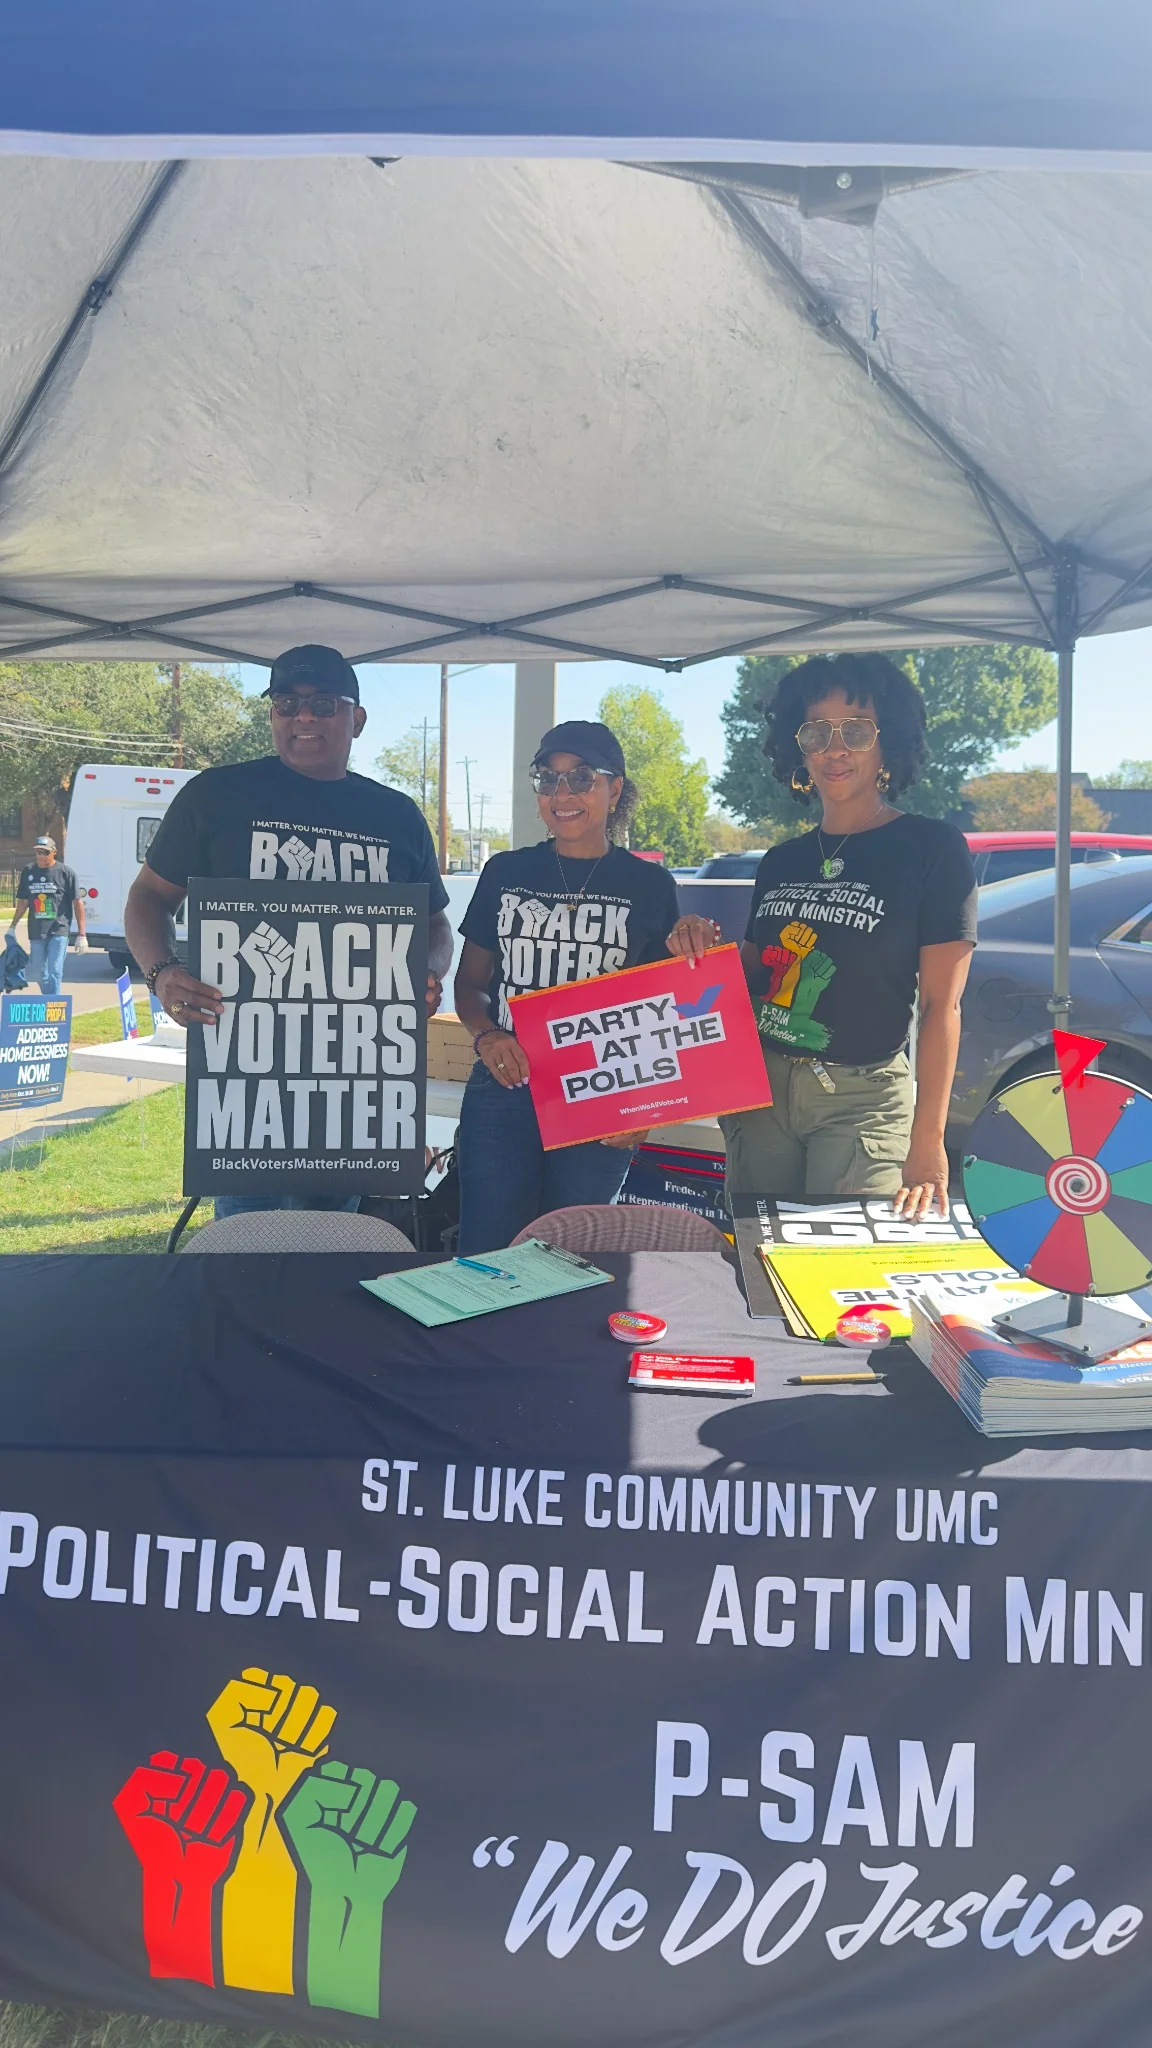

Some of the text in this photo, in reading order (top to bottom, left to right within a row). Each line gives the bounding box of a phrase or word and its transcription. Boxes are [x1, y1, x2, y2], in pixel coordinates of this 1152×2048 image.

[256, 821, 291, 830] MATTER.
[292, 824, 310, 832] YOU
[311, 827, 345, 838] MATTER.
[809, 881, 852, 889] COMMUNITY
[851, 881, 870, 892] UMC
[199, 901, 417, 916] I MATTER. YOU MATTER. WE MATTER.
[553, 892, 586, 900] MATTER.
[601, 895, 633, 906] MATTER.
[799, 902, 880, 933] MINISTRY
[10, 1003, 31, 1022] VOTE
[31, 1003, 46, 1022] FOR
[61, 1008, 66, 1021] A
[552, 998, 670, 1045] PARTY
[761, 1004, 791, 1027] P-SAM
[16, 1027, 59, 1045] ADDRESS
[200, 1001, 417, 1076] VOTERS
[601, 1016, 721, 1064] AT THE
[0, 1043, 68, 1064] HOMELESSNESS
[17, 1063, 51, 1085] NOW!
[565, 1057, 677, 1099] POLLS
[196, 1078, 416, 1150] MATTER
[619, 1096, 689, 1116] WhenWeAllVote.org
[212, 1158, 400, 1172] BlackVotersMatterFund.org
[705, 1206, 715, 1218] in
[756, 1199, 771, 1225] MATTER.
[759, 1223, 773, 1238] WE
[361, 1457, 998, 1546] ST. LUKE COMMUNITY UMC
[695, 1564, 971, 1660] ACTION
[653, 1720, 976, 1848] P-SAM
[659, 1849, 828, 1966] DO
[825, 1860, 1144, 1961] Justice
